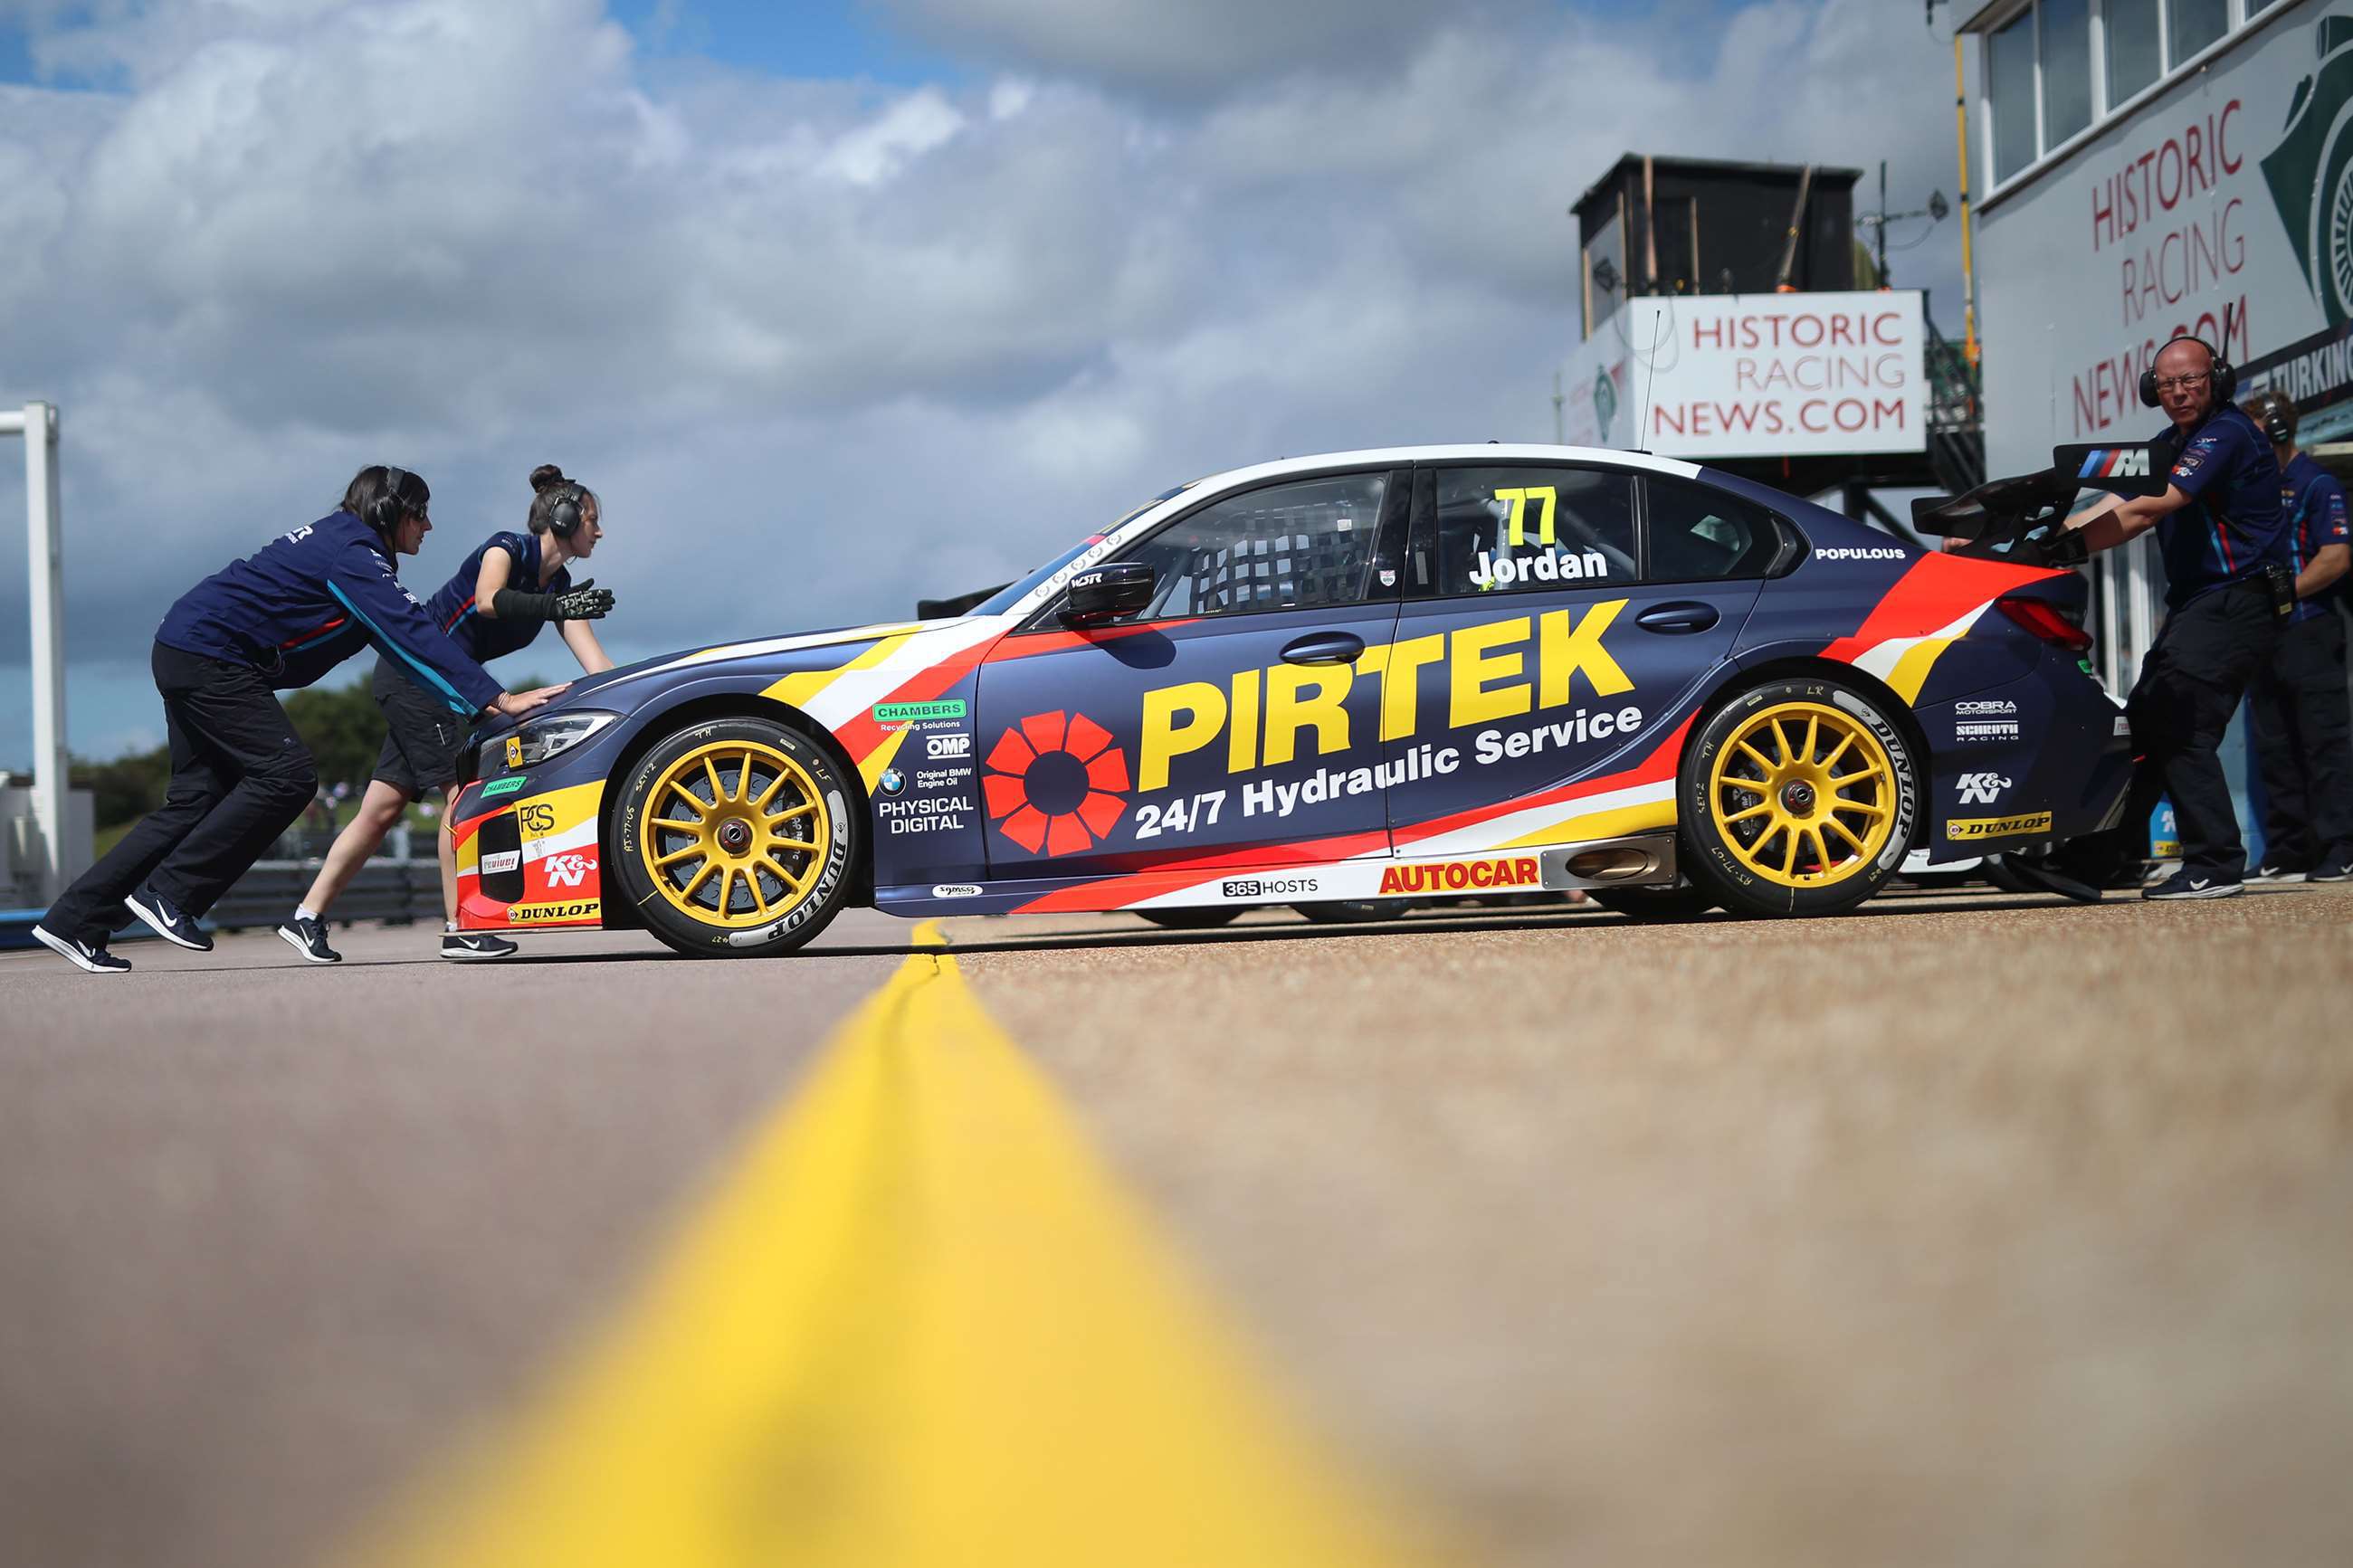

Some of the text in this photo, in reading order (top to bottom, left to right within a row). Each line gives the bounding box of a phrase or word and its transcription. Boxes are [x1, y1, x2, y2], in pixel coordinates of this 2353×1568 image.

[2092, 100, 2243, 252] HISTORIC
[2122, 197, 2245, 327] RACING
[1693, 312, 1903, 349] HISTORIC
[1736, 353, 1906, 392] RACING
[1653, 397, 1905, 436] NEWS.COM
[1494, 486, 1557, 546] 77
[1815, 548, 1906, 560] POPULOUS
[1469, 547, 1608, 585] Jordan
[1138, 598, 1635, 793] PIRTEK
[1955, 700, 2017, 710] COBRA
[878, 703, 962, 717] CHAMBERS
[881, 720, 960, 731] Recycling Solutions
[927, 738, 971, 755] OMP
[917, 768, 972, 780] Original BMW
[917, 777, 957, 789] Engine Oil
[1135, 706, 1643, 840] 24/7 Hydraulic Service
[1872, 720, 1915, 840] DUNLOP
[485, 780, 522, 794] CHAMBERS
[879, 796, 973, 817] PHYSICAL
[891, 815, 964, 833] DIGITAL
[1967, 817, 2050, 834] DUNLOP
[1379, 859, 1538, 894] AUTOCAR
[767, 839, 846, 941] DUNLOP
[1224, 879, 1319, 897] 365 HOSTS
[520, 903, 598, 919] DUNLOP
